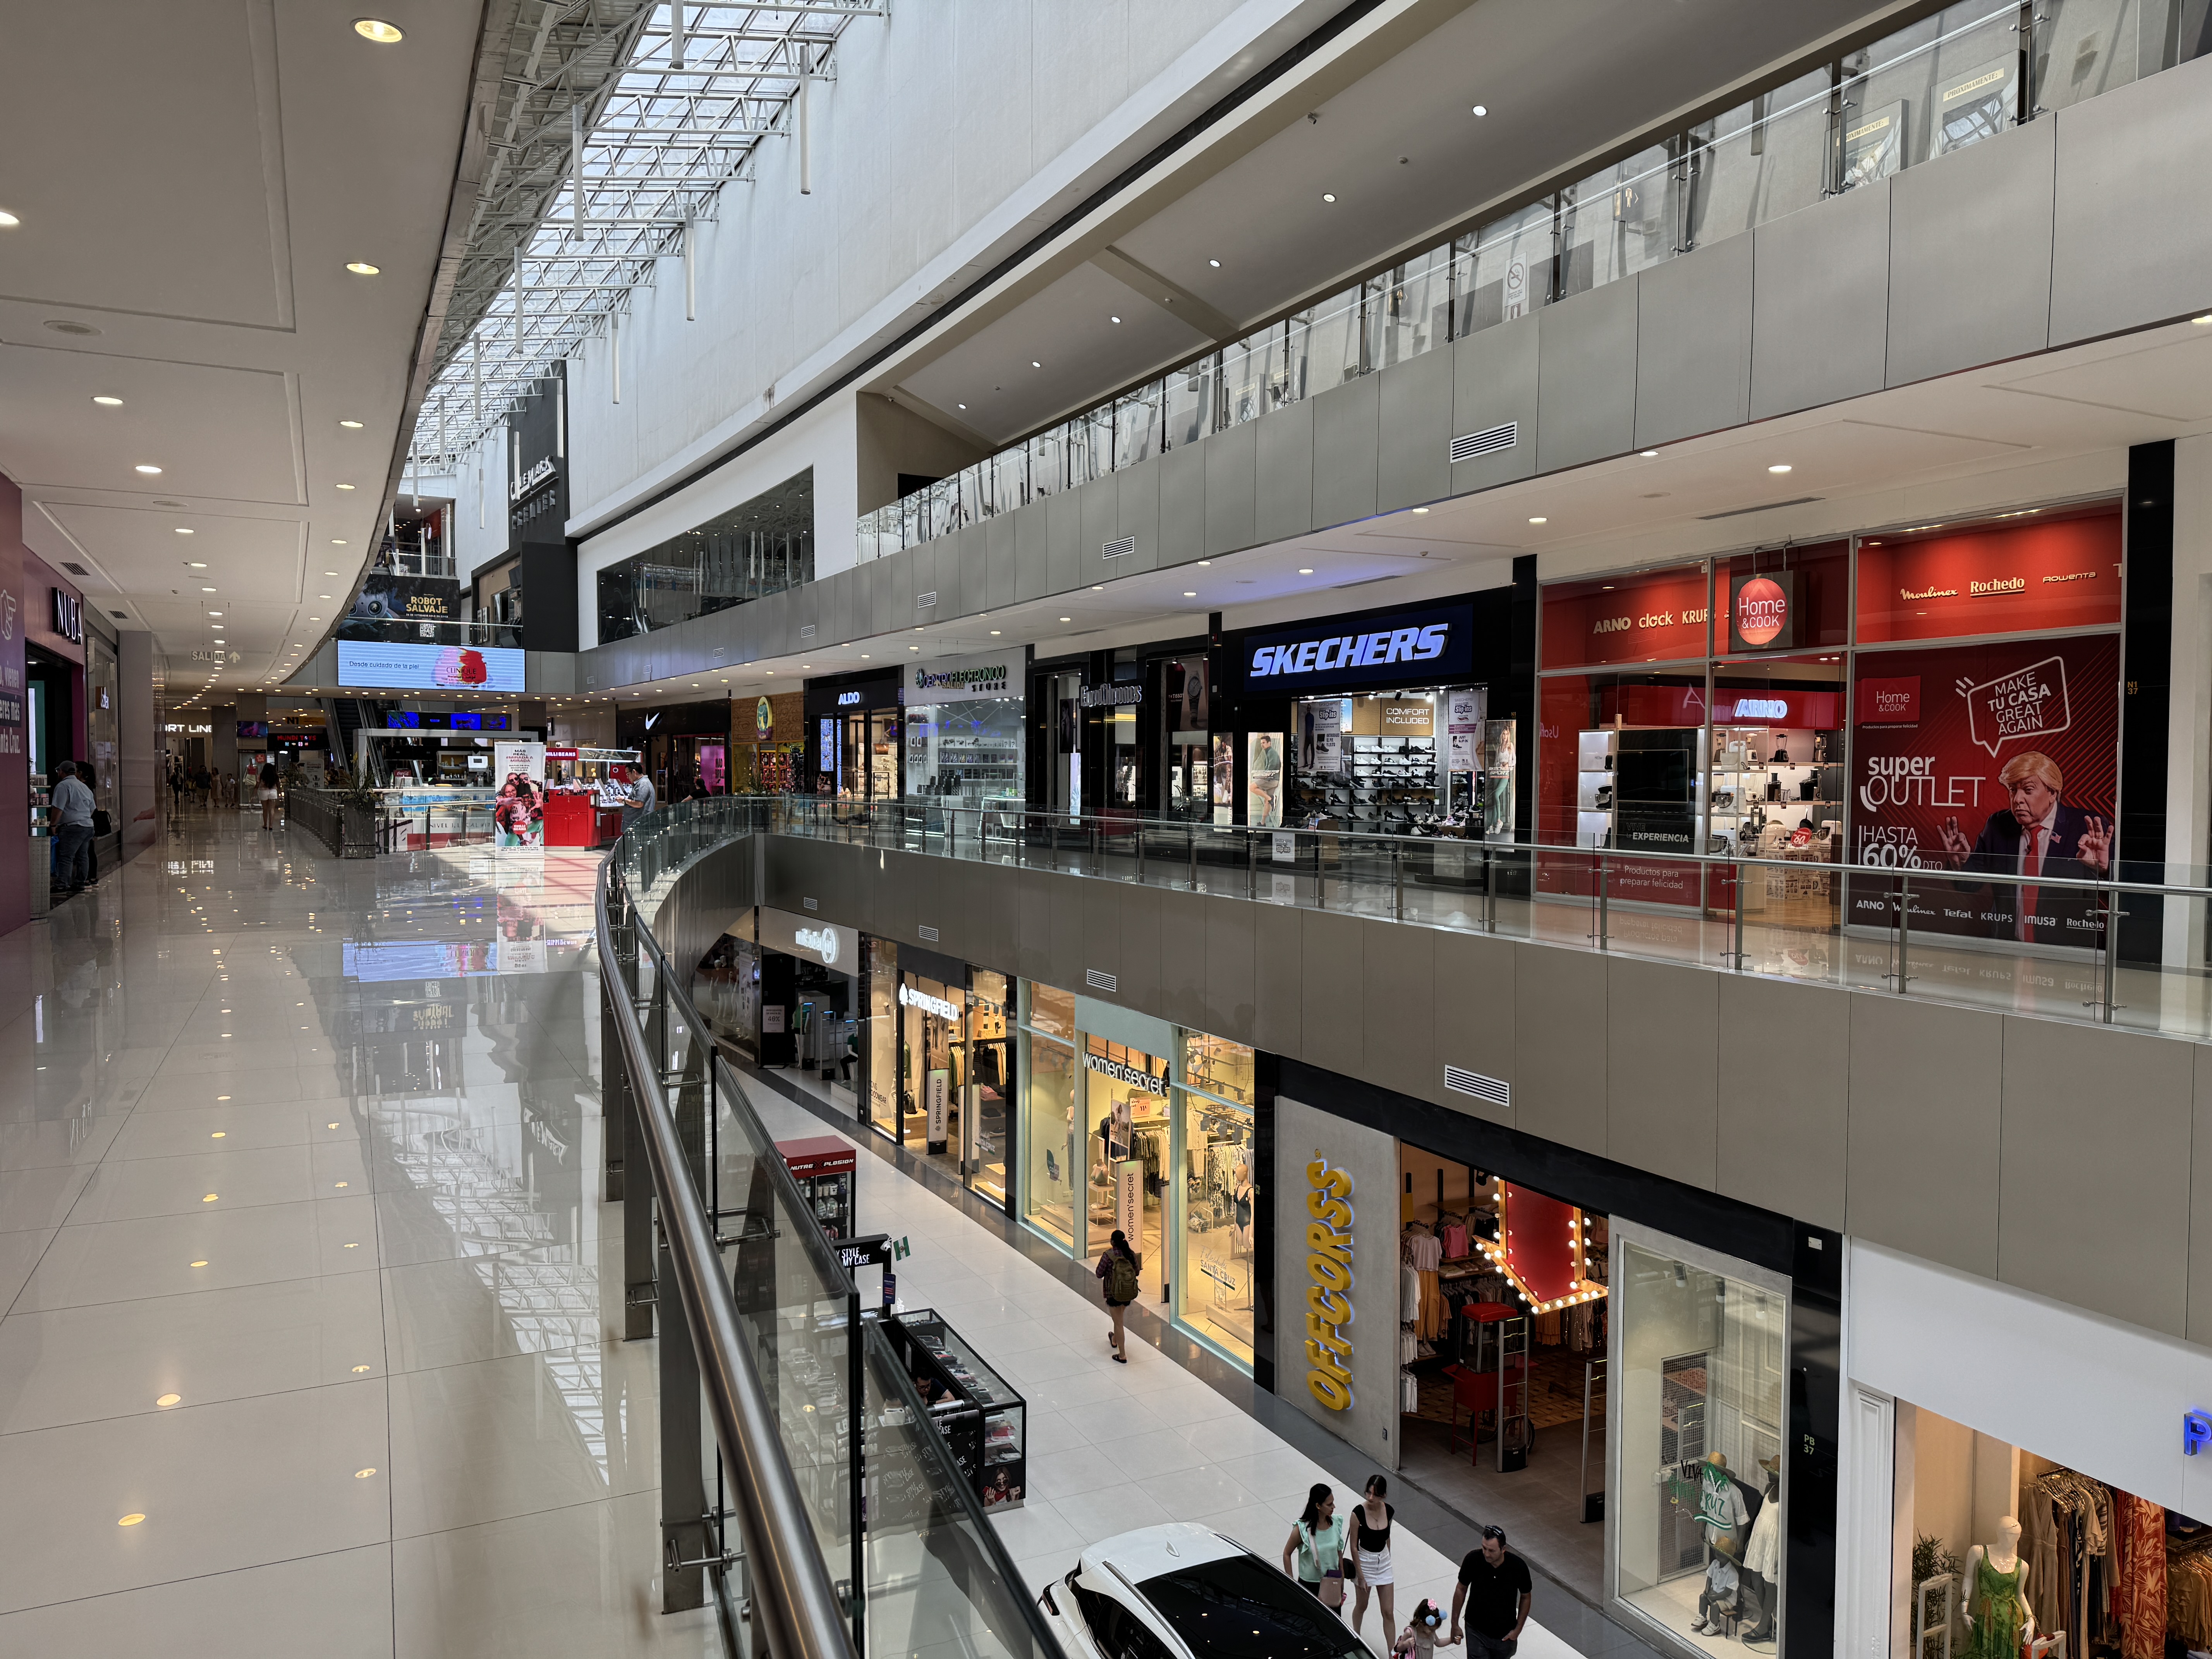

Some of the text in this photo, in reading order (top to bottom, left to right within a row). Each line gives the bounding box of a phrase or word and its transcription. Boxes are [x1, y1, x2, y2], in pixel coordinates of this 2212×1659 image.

[1947, 72, 1998, 98] PROXIMAMENTE:
[1846, 120, 1884, 140] OXIMAMENTE:
[510, 455, 556, 501] CEMARK
[1900, 586, 1958, 601] Moulinex
[1970, 577, 2025, 593] Rochedo
[406, 603, 448, 613] SALVAJE
[411, 596, 443, 605] ROBOT
[1738, 597, 1785, 616] Home
[57, 587, 82, 645] NUBA
[1593, 617, 1631, 634] ARNO
[1742, 615, 1779, 629] &COOK
[192, 651, 226, 661] SALIDA
[1250, 623, 1450, 677] SKECHERS
[5, 661, 19, 688] vienen
[1995, 672, 2036, 696] MAKE
[838, 692, 860, 705] ALDO
[1876, 691, 1910, 704] Home
[1987, 683, 2051, 712] TU CASA
[1735, 699, 1788, 718] ARNO
[1879, 703, 1906, 712] &COOK
[1996, 702, 2043, 723] GREAT
[1998, 715, 2043, 736] AGAIN
[1868, 756, 1935, 782] super
[1867, 775, 1986, 807] OUTLET
[1626, 823, 1646, 831] VIVE
[1863, 825, 1918, 844] HASTA
[1633, 832, 1689, 843] EXPERIENCIA
[1863, 843, 1942, 871] 60% DTO
[1625, 865, 1678, 879] Productos para
[1620, 878, 1683, 889] preparar felicidad
[1856, 900, 1884, 910] ARNO
[1893, 902, 1936, 915] Mulinex
[1943, 908, 1973, 919] Tefal
[1981, 912, 2013, 923] KRUPS
[908, 988, 959, 1021] SPRINGFIELD
[1082, 1051, 1167, 1097] women'secret
[842, 1247, 860, 1259] STYLE
[843, 1254, 870, 1266] MY CASE
[1200, 1260, 1236, 1286] SANTA CRUZ
[1305, 1158, 1354, 1411] OFFCORSS
[1804, 1434, 1815, 1445] PB
[1803, 1444, 1814, 1455] 37
[957, 1455, 967, 1467] ASE
[1680, 1460, 1704, 1484] VIVA
